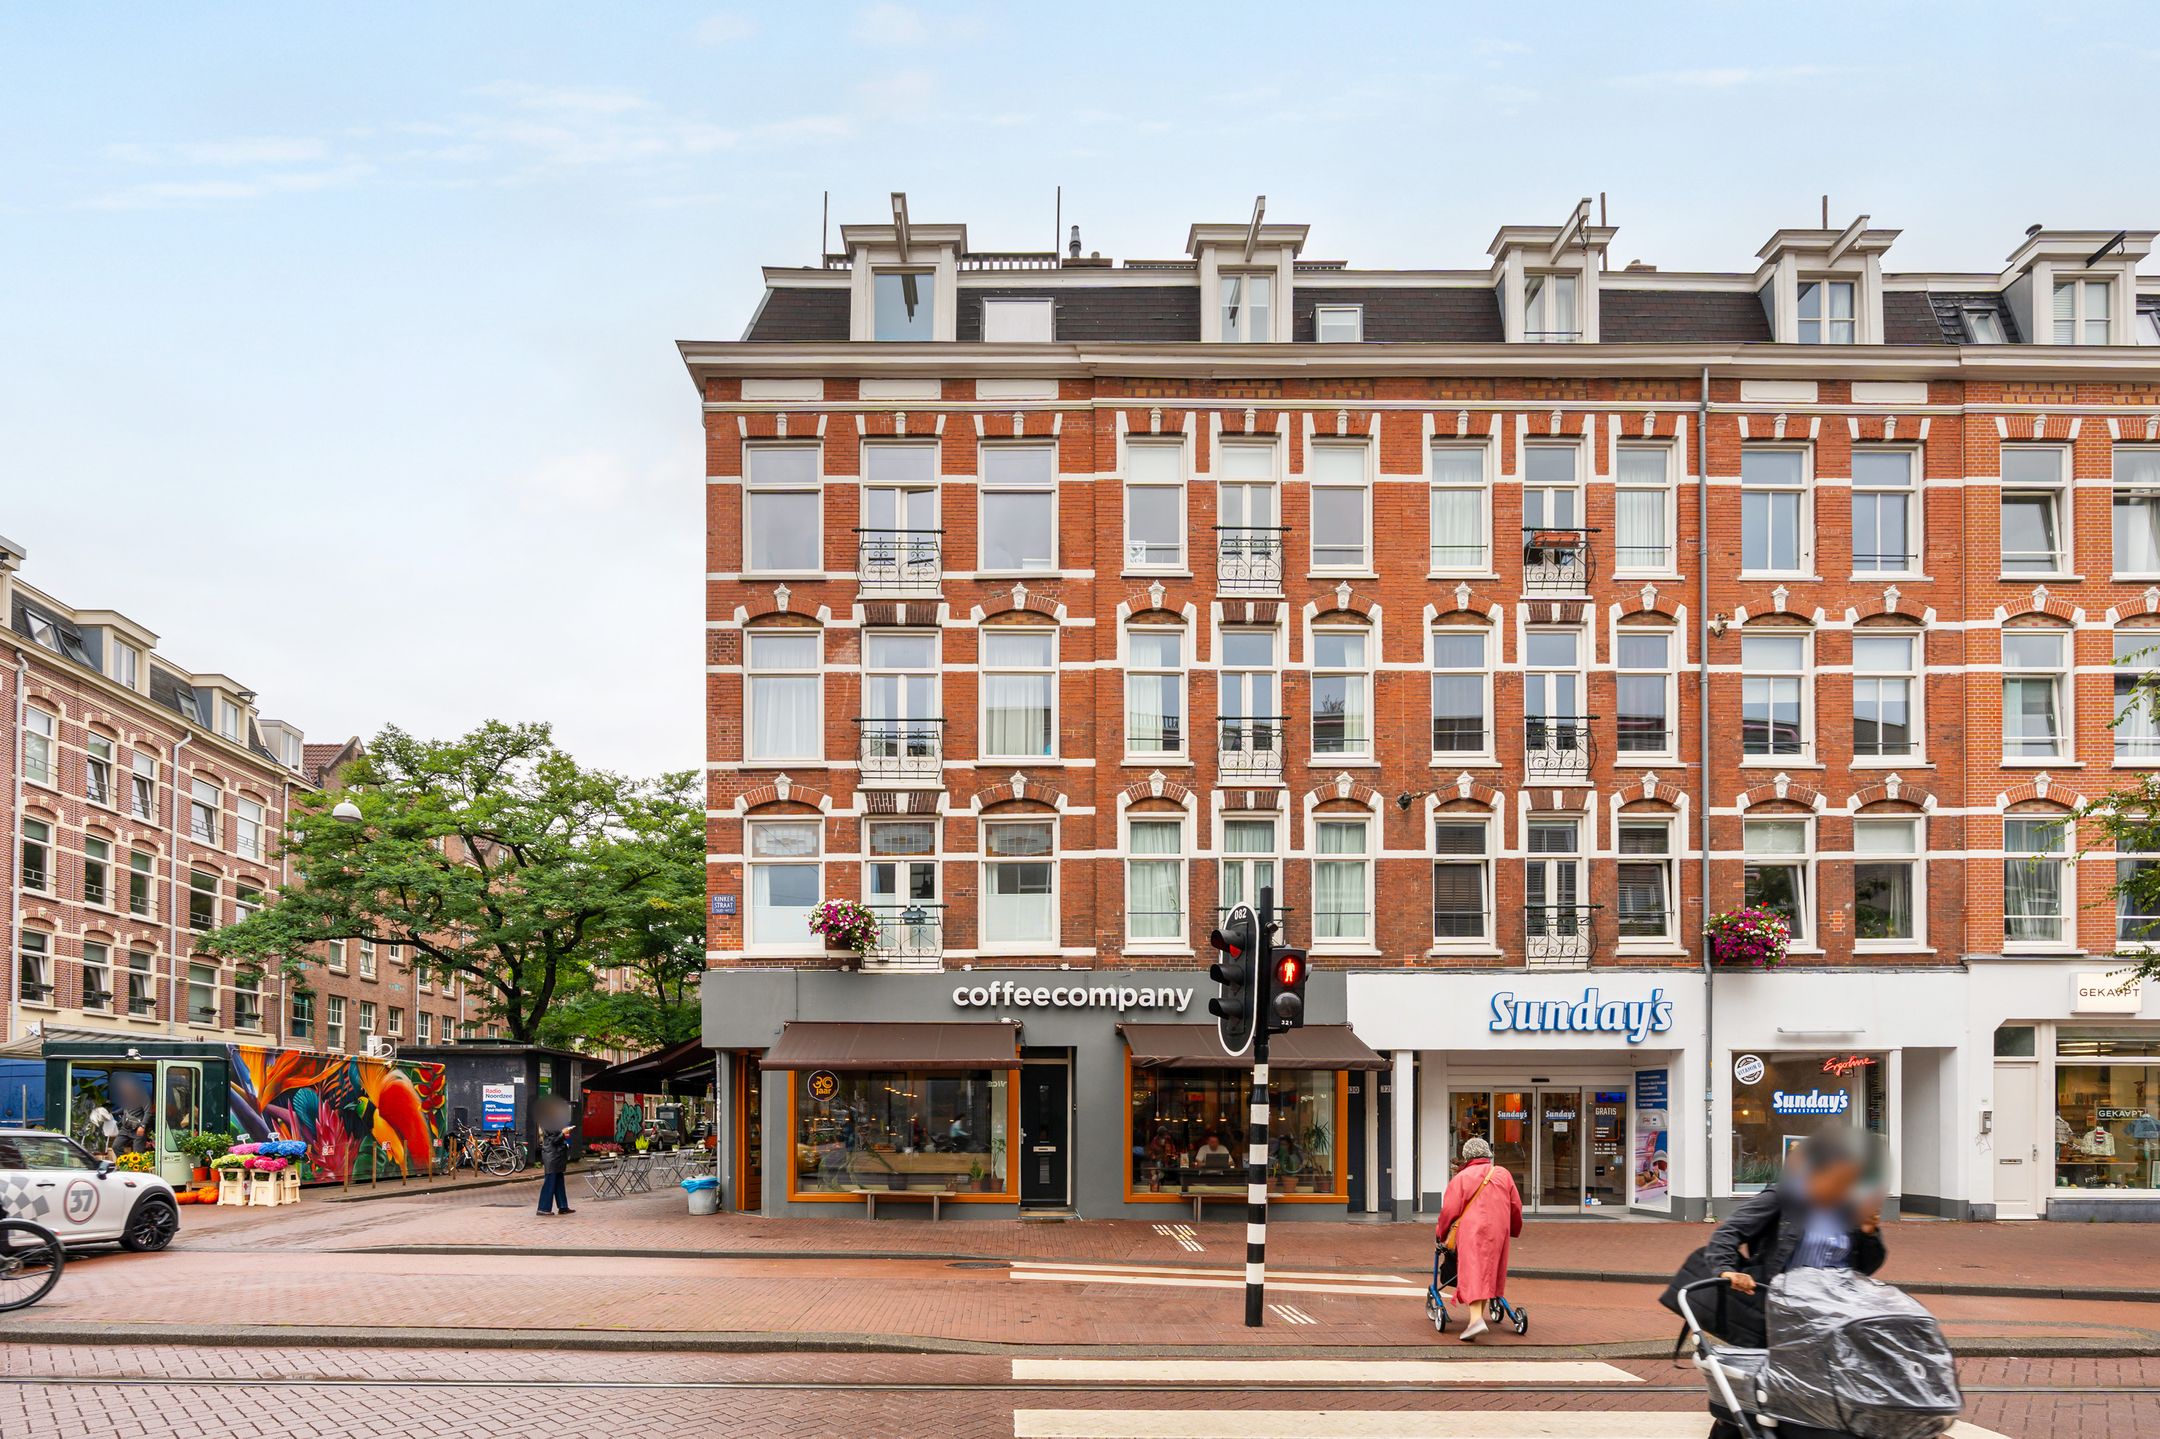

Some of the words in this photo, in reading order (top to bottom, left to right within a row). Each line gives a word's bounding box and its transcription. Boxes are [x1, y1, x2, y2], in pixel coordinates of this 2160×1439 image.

[1234, 908, 1247, 920] 082
[952, 981, 1194, 1012] coffeecompany
[1490, 988, 1673, 1043] Sunday's
[1737, 1064, 1757, 1076] VITAMIN
[1823, 1056, 1876, 1076] Ergoline
[816, 1088, 832, 1096] jaar
[1773, 1090, 1848, 1113] Sunday's
[1497, 1109, 1528, 1119] Sunday's
[1545, 1109, 1576, 1119] Sunday's
[1595, 1107, 1617, 1115] GRATIS
[70, 1189, 93, 1213] 37
